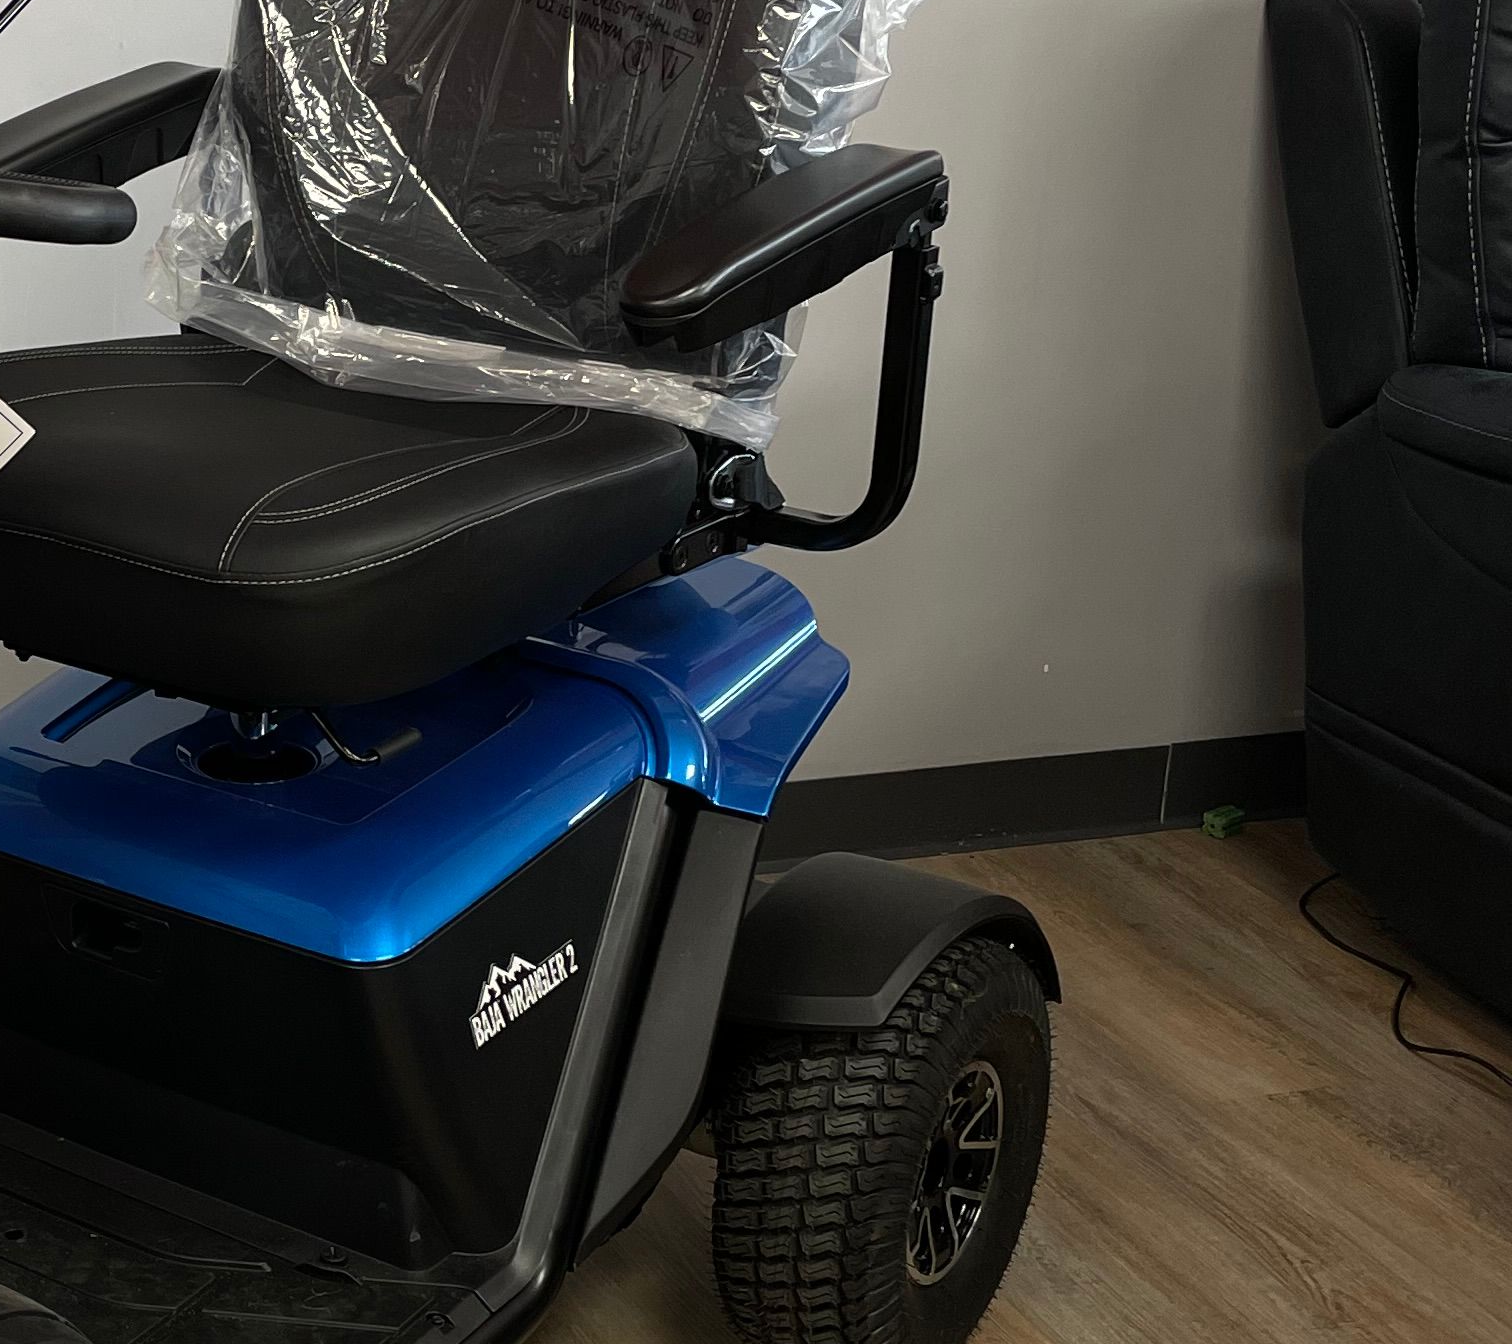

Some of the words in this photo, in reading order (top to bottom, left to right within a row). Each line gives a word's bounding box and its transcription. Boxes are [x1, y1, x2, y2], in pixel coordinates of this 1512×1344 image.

[645, 13, 672, 35] THIS
[692, 7, 713, 25] DO
[673, 24, 704, 47] KEEP
[471, 1000, 506, 1047] BAJA
[502, 951, 569, 1022] WRANGLER
[565, 943, 579, 974] 2
